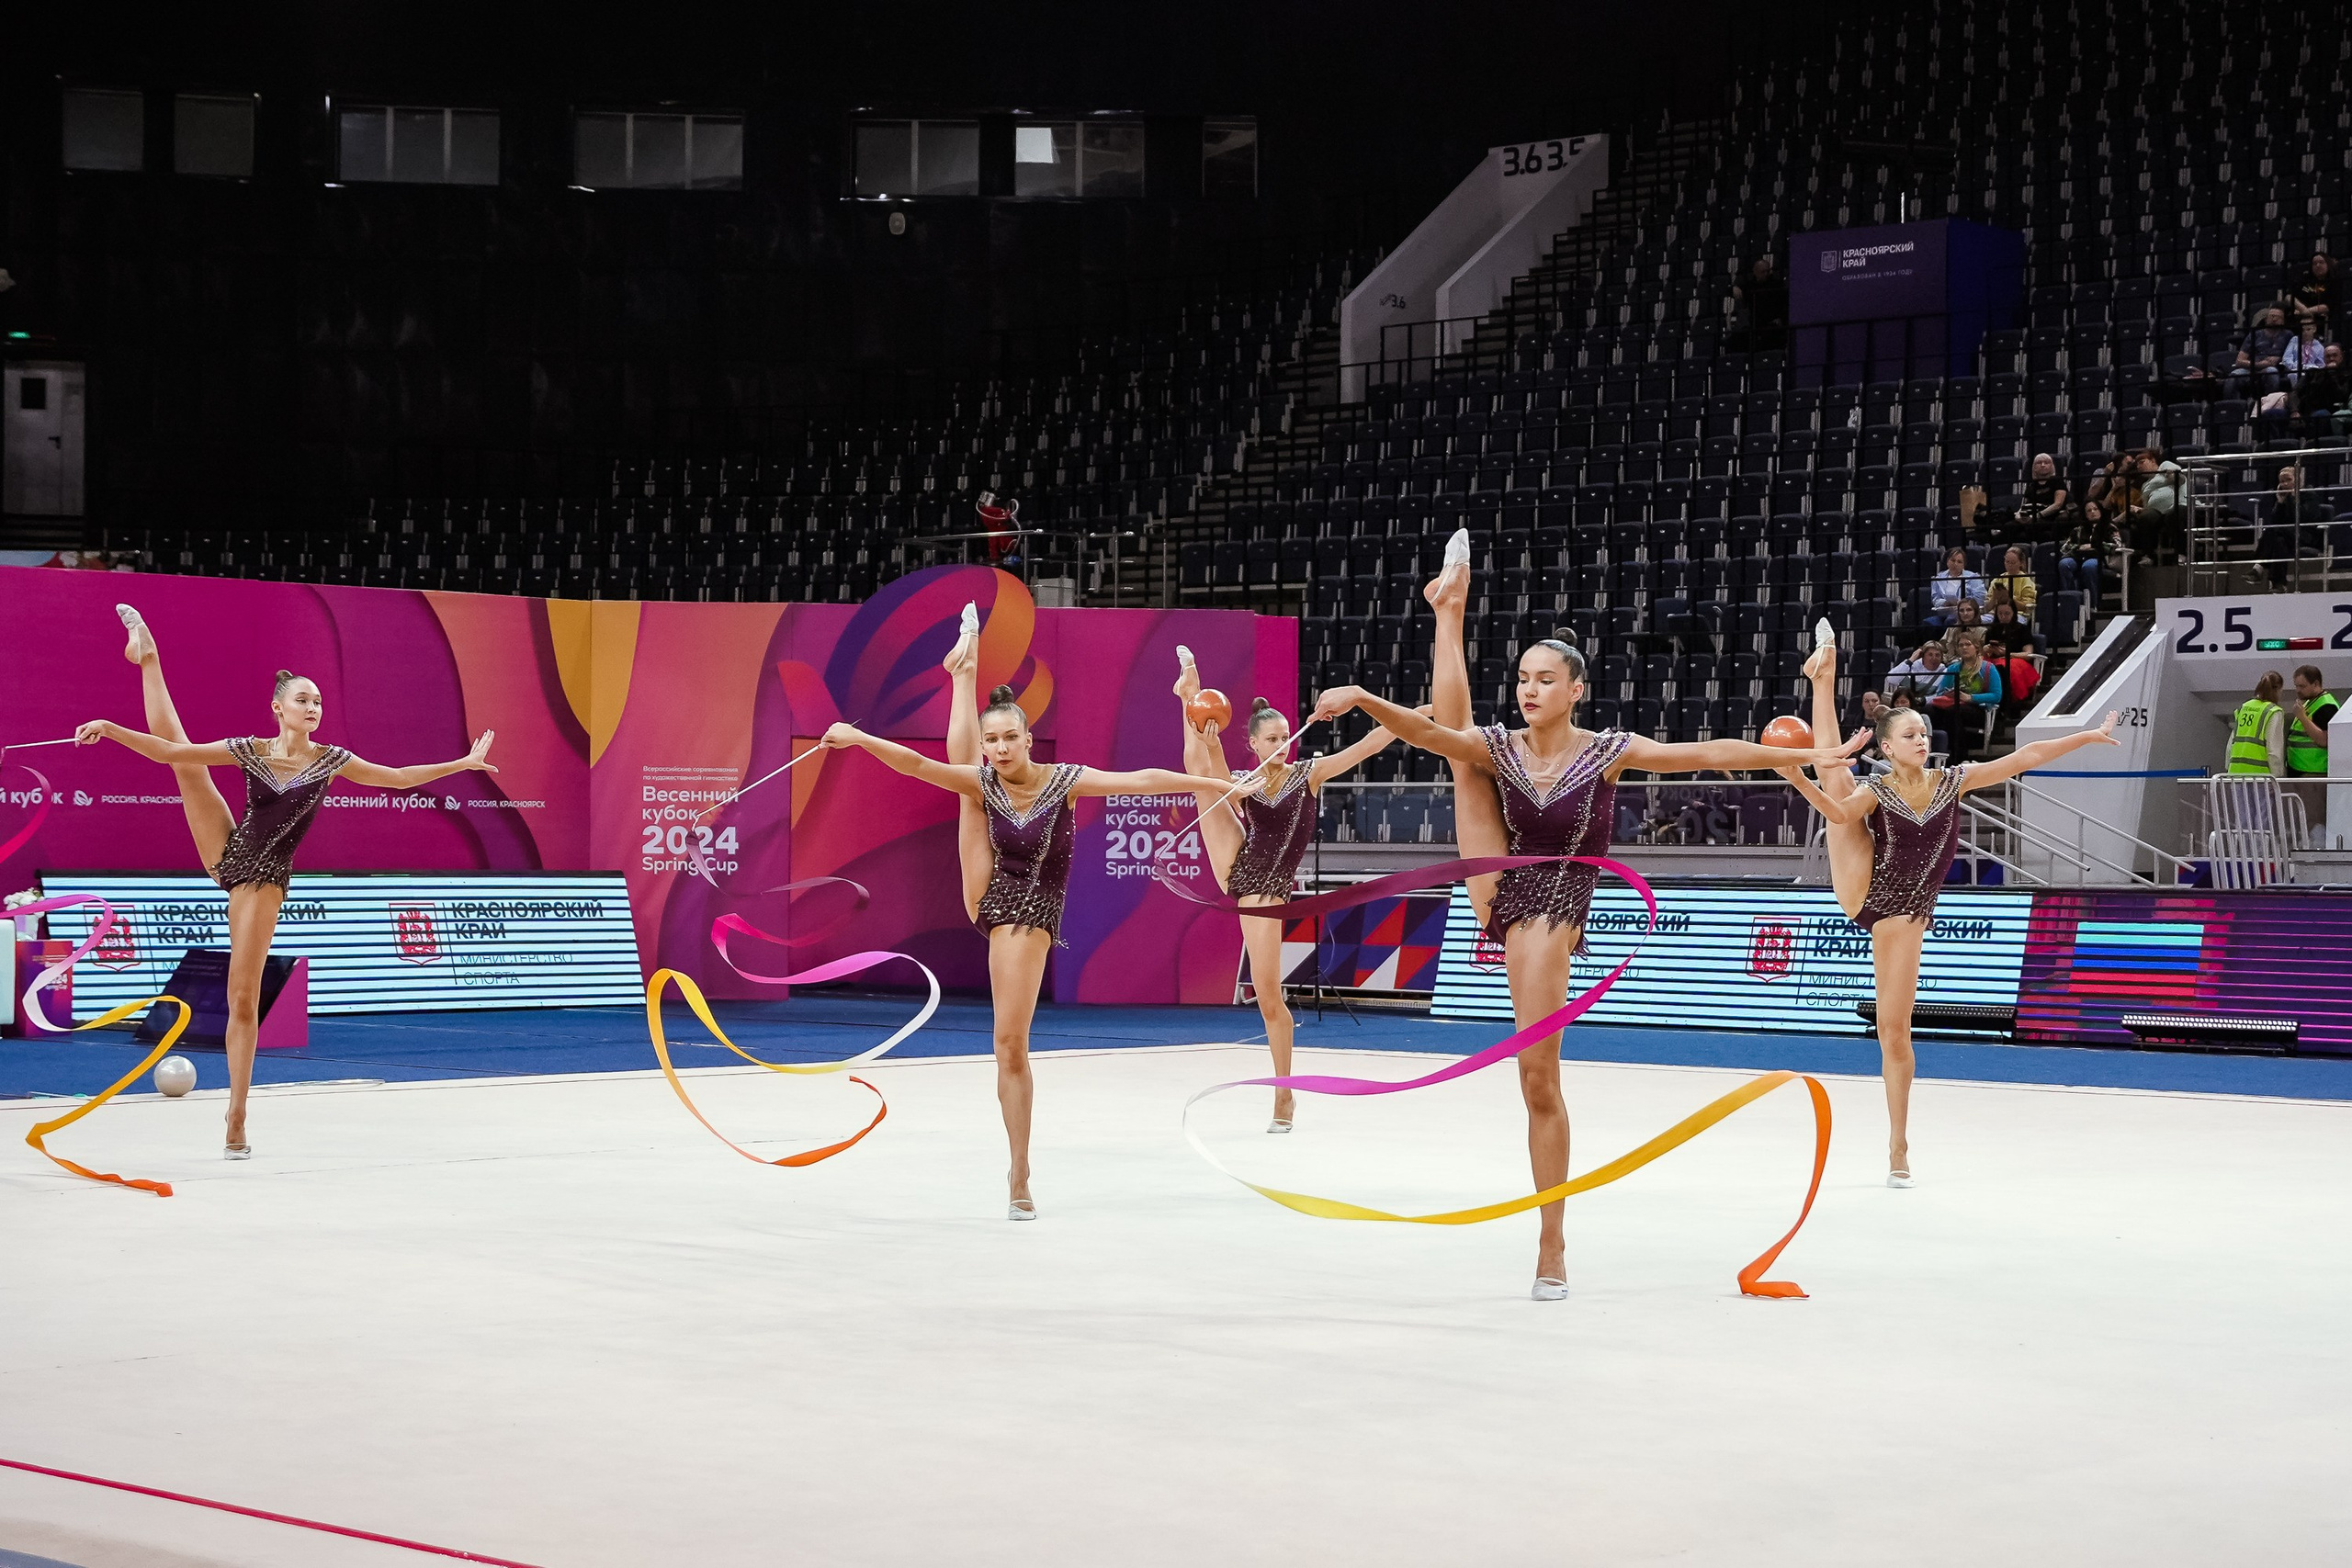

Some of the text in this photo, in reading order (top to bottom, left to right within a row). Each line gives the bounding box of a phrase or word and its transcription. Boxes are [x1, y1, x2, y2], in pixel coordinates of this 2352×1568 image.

[1503, 143, 1543, 176] 3.6
[1842, 241, 1915, 258] КРАСНОЯРСКИЙ
[1842, 256, 1866, 268] КРАЙ
[2176, 606, 2254, 653] 2.5
[2239, 713, 2255, 727] 38
[11, 787, 63, 808] кубк
[101, 795, 140, 804] РОССИЯ,
[322, 793, 436, 813] есенний кубок
[468, 800, 546, 808] РОССИЯ, КРАСНОЯРСК
[643, 786, 739, 802] Весенний
[642, 805, 700, 825] кубок
[1105, 809, 1161, 829] кубок
[642, 825, 740, 855] 2024
[1105, 829, 1202, 860] 2024
[642, 856, 739, 876] Spring Cup
[1105, 861, 1201, 881] Spring Cup
[451, 899, 604, 919] КРАСНОЯРСКИЙ
[156, 925, 215, 944] КРАЙ
[454, 921, 506, 939] КРАЙ
[1813, 937, 1869, 958] КРАЙ
[459, 953, 574, 965] МИНИСТЕРСТВО
[463, 971, 521, 985] СПОРТА
